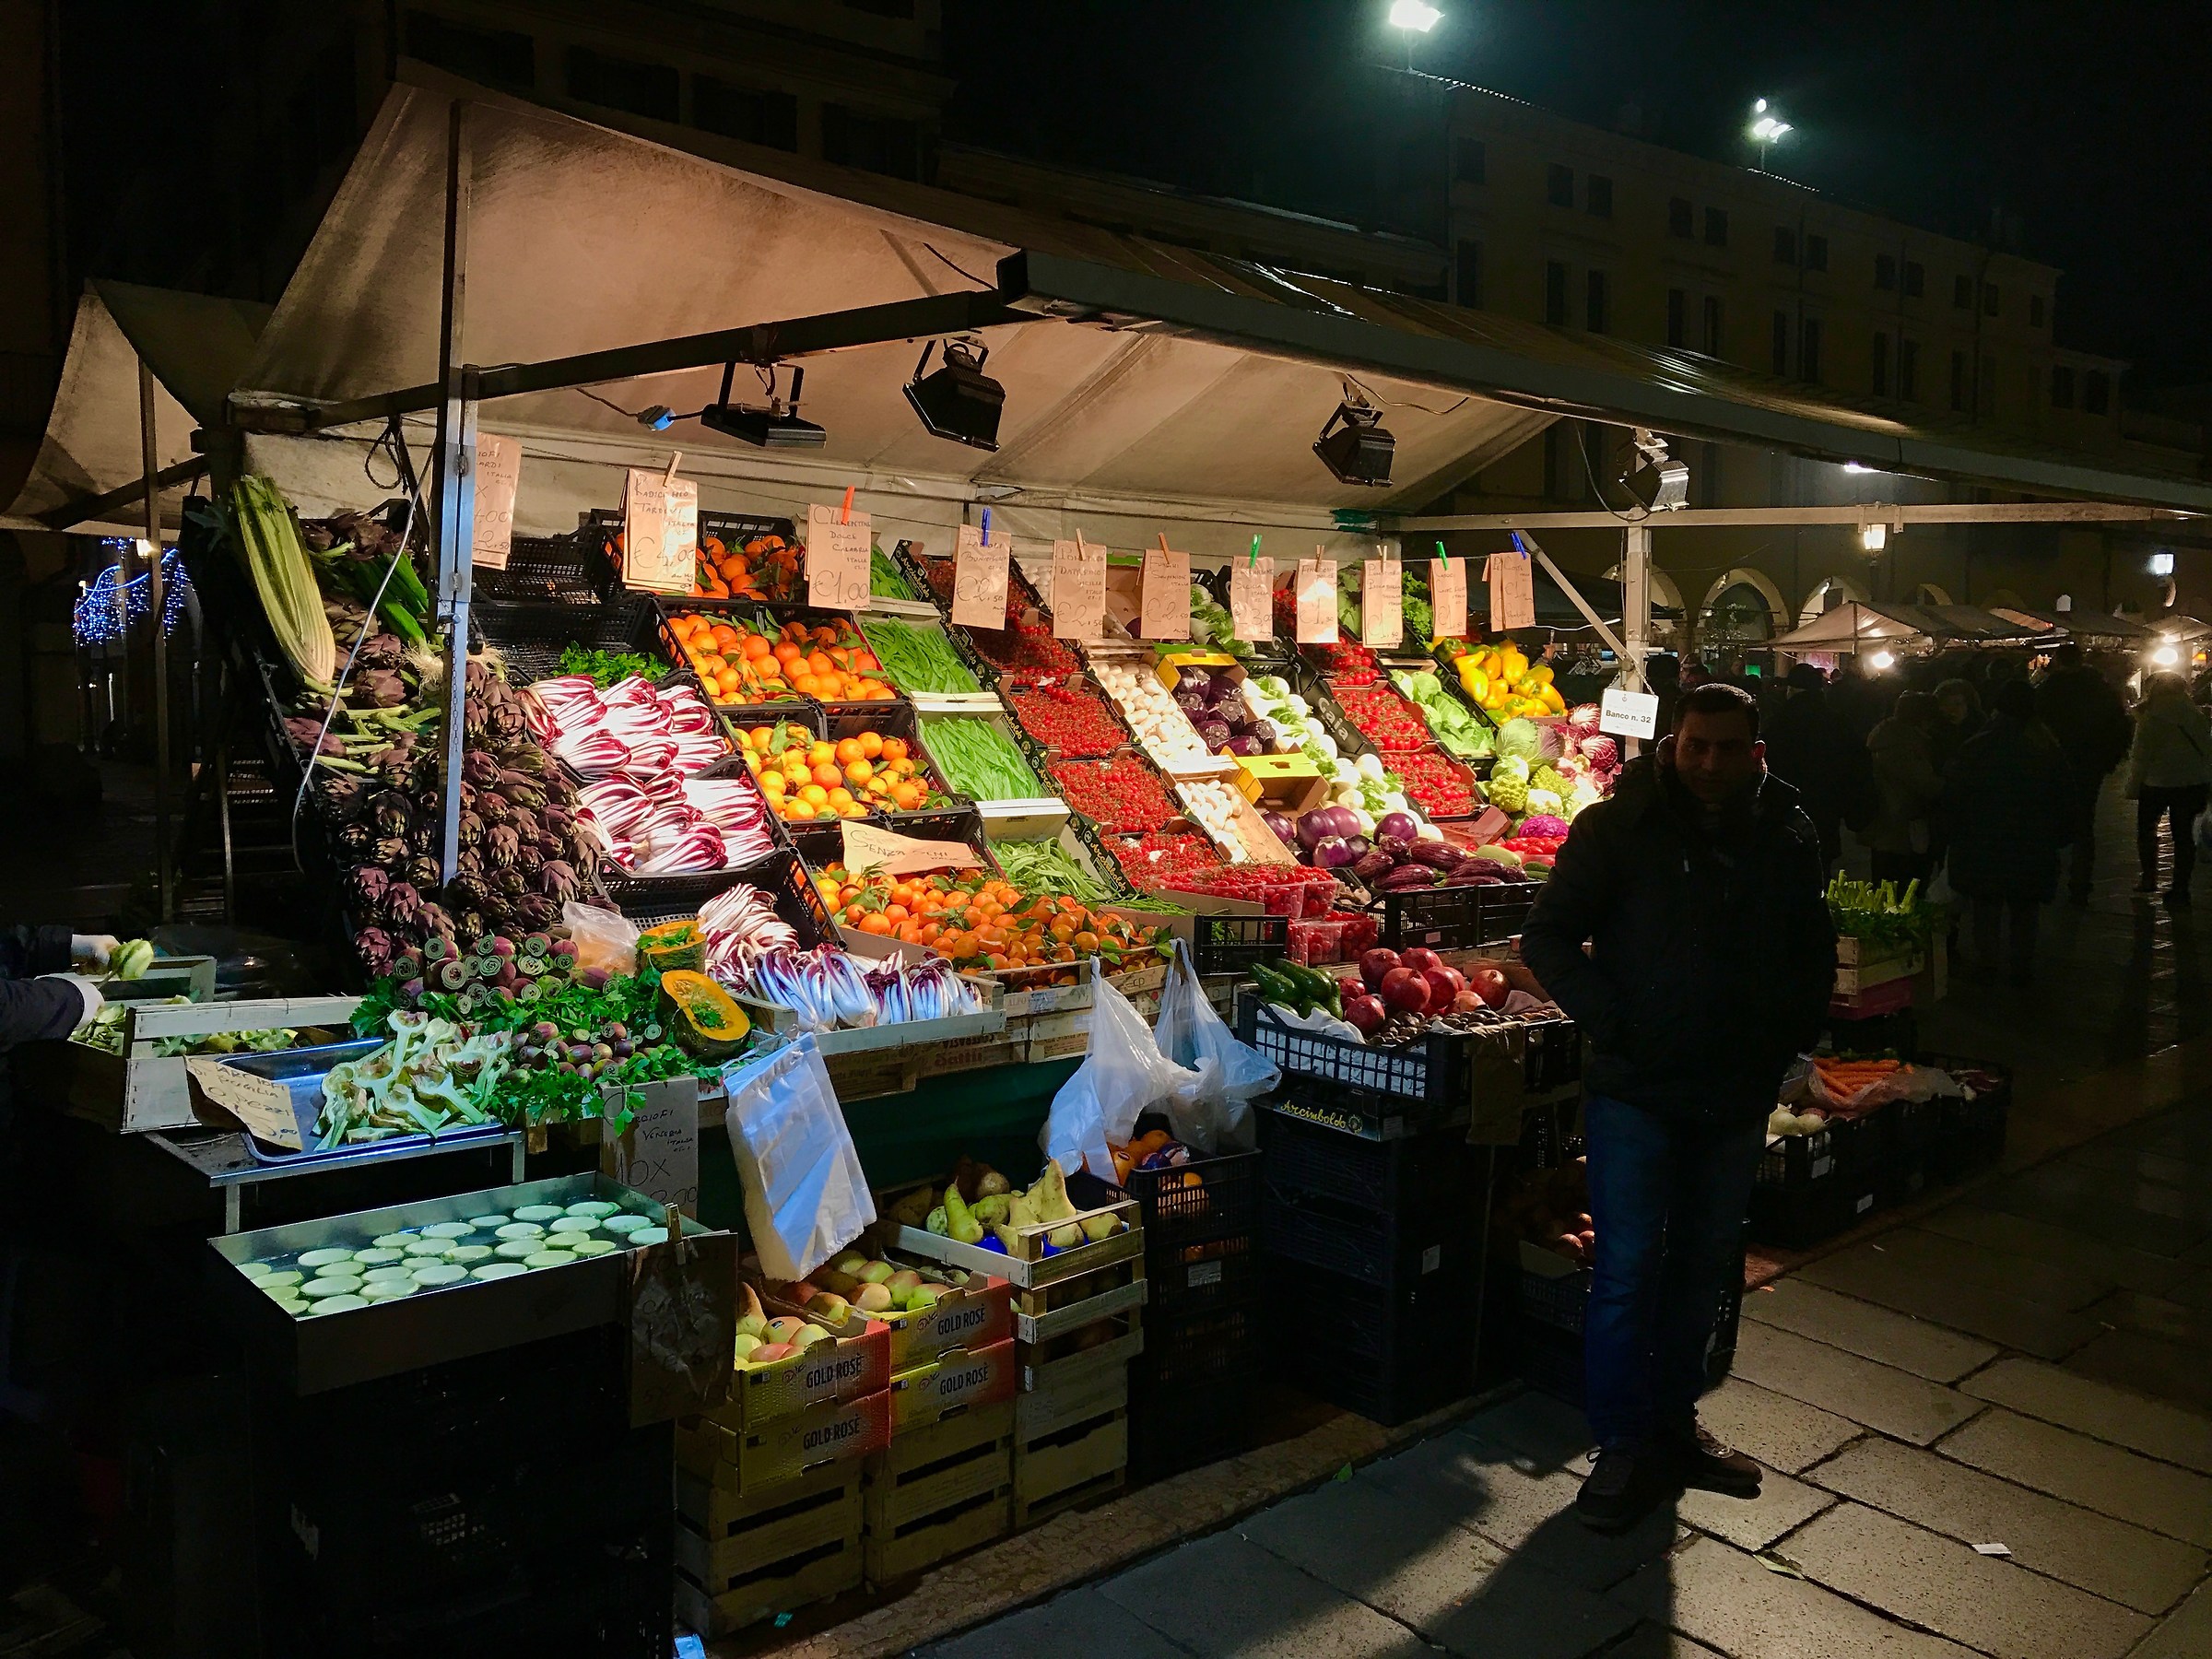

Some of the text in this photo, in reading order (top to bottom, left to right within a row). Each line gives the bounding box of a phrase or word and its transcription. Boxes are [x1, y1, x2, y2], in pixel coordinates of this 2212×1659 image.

[634, 474, 689, 497] RADICHIO
[1318, 697, 1349, 741] Gaia
[1606, 710, 1630, 720] Banco
[1641, 715, 1652, 724] 32
[604, 1092, 674, 1127] CRCIOFI
[1280, 1100, 1347, 1129] Arcimboldo
[937, 1315, 961, 1335] GOLD
[806, 1367, 833, 1389] GOLD
[940, 1374, 964, 1395] GOLD
[803, 1428, 831, 1450] GOLD
